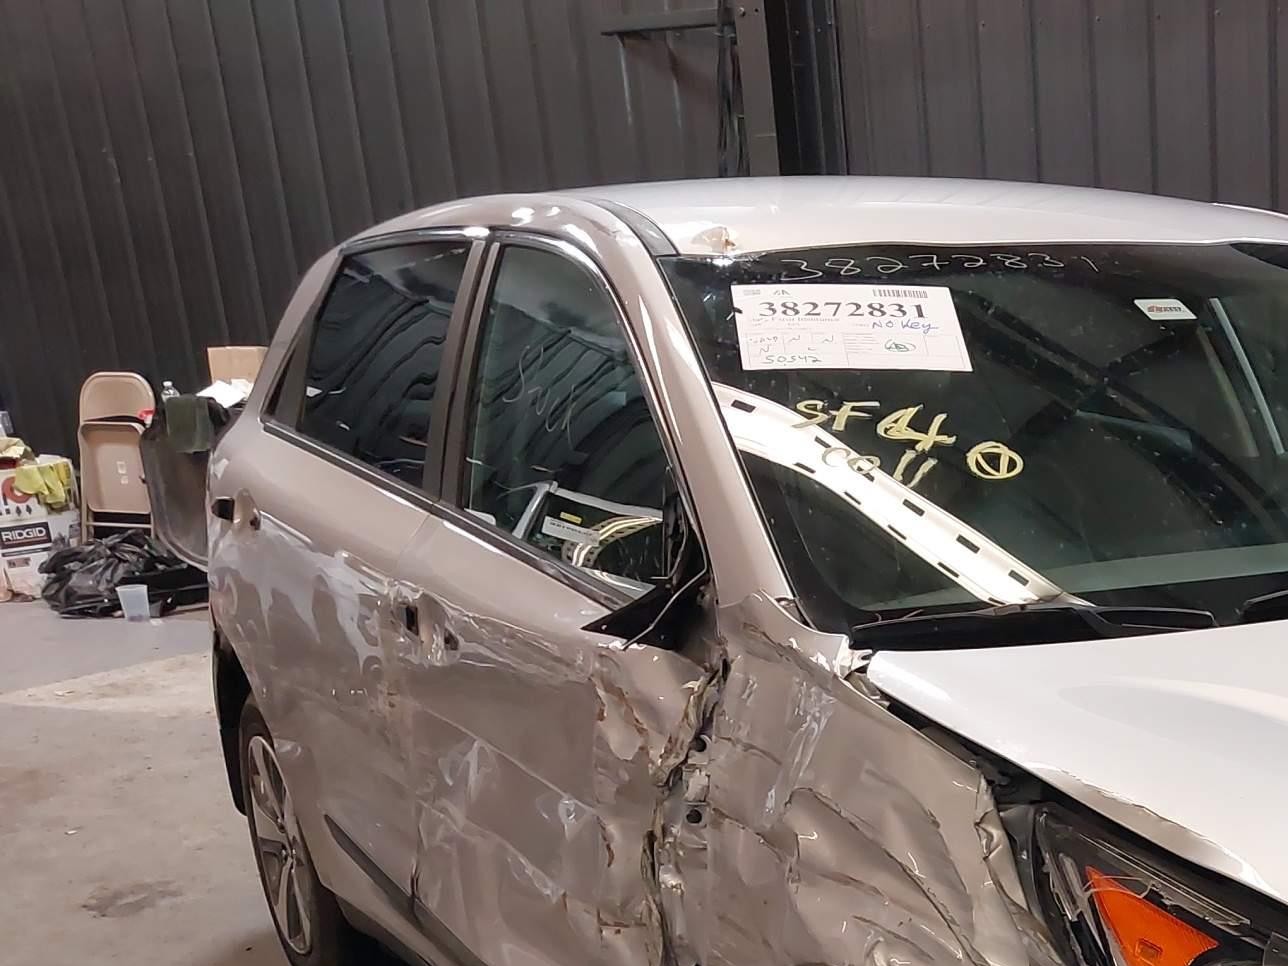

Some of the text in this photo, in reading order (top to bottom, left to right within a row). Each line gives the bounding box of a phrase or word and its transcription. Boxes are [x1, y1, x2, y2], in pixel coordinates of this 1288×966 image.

[780, 254, 1099, 280] 38272831
[758, 302, 927, 319] 38272831
[1, 527, 46, 541] RIDGID
